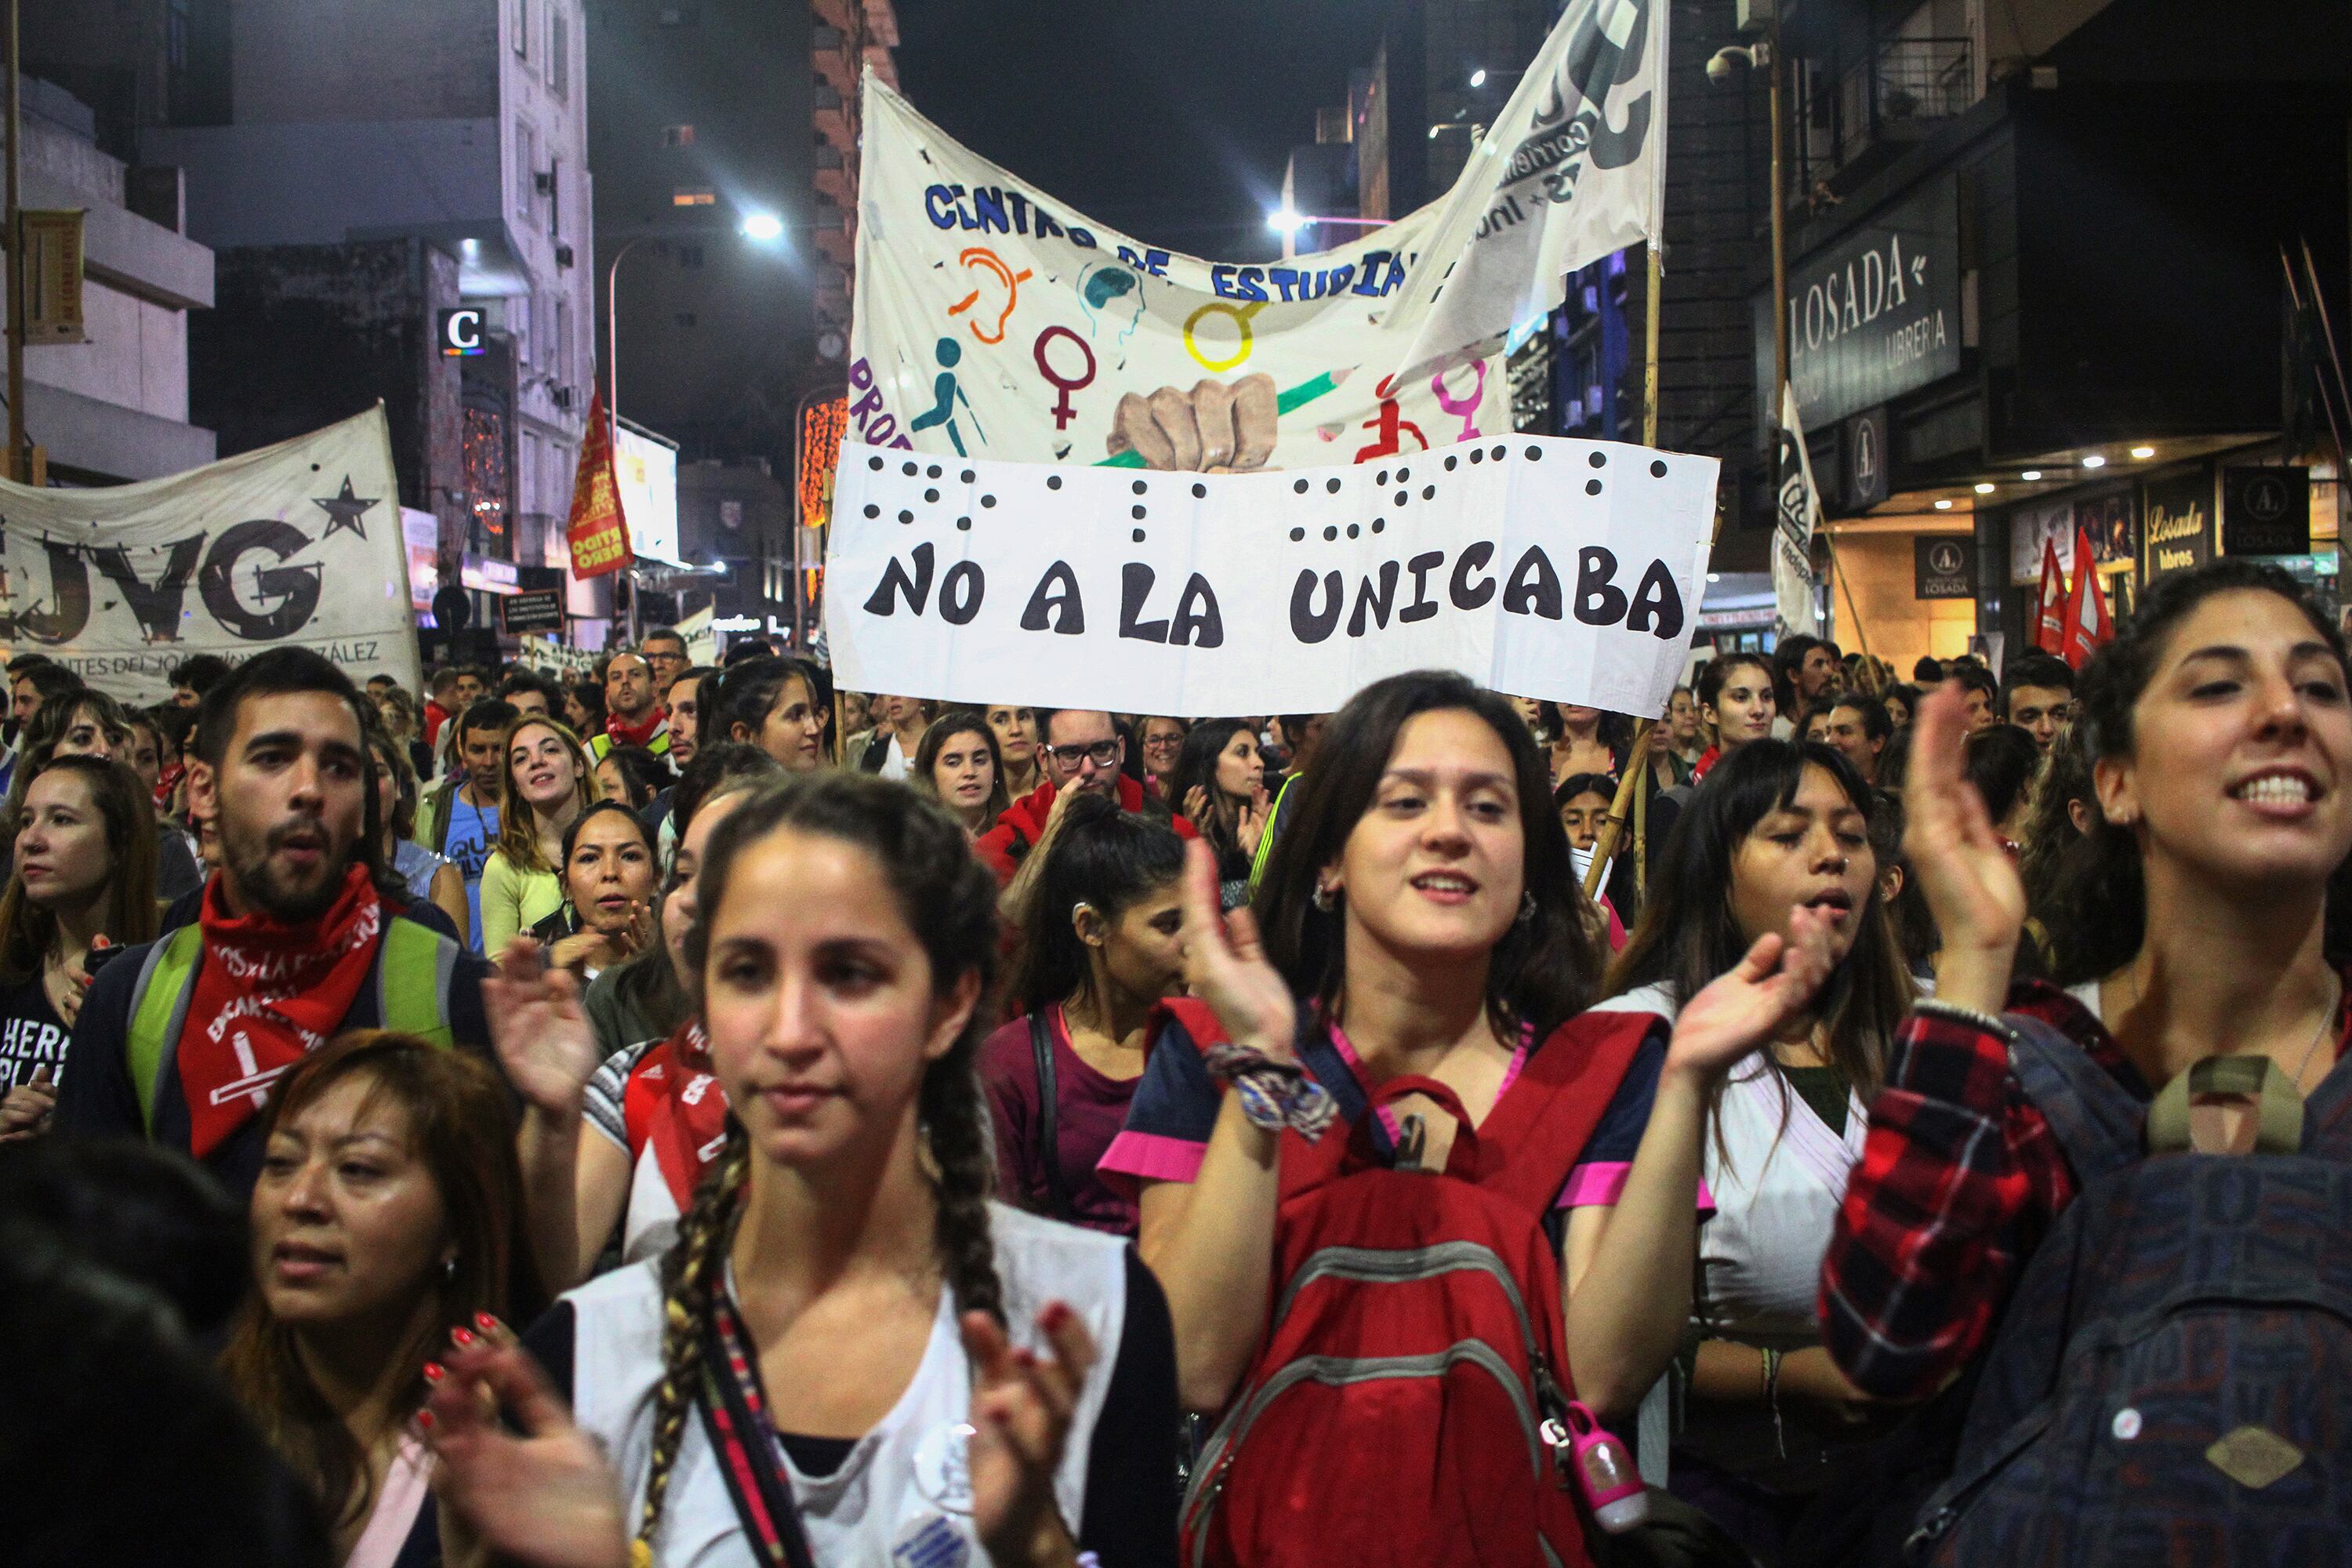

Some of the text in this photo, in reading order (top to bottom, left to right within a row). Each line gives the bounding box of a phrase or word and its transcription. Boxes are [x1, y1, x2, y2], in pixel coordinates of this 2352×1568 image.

[1211, 251, 1417, 302] ESTUDIA
[1790, 234, 1906, 360] LOSADA
[448, 310, 479, 349] C
[2149, 501, 2204, 545] Losada
[2159, 549, 2195, 571] libros
[863, 541, 1685, 648] NO A LA UNICABA
